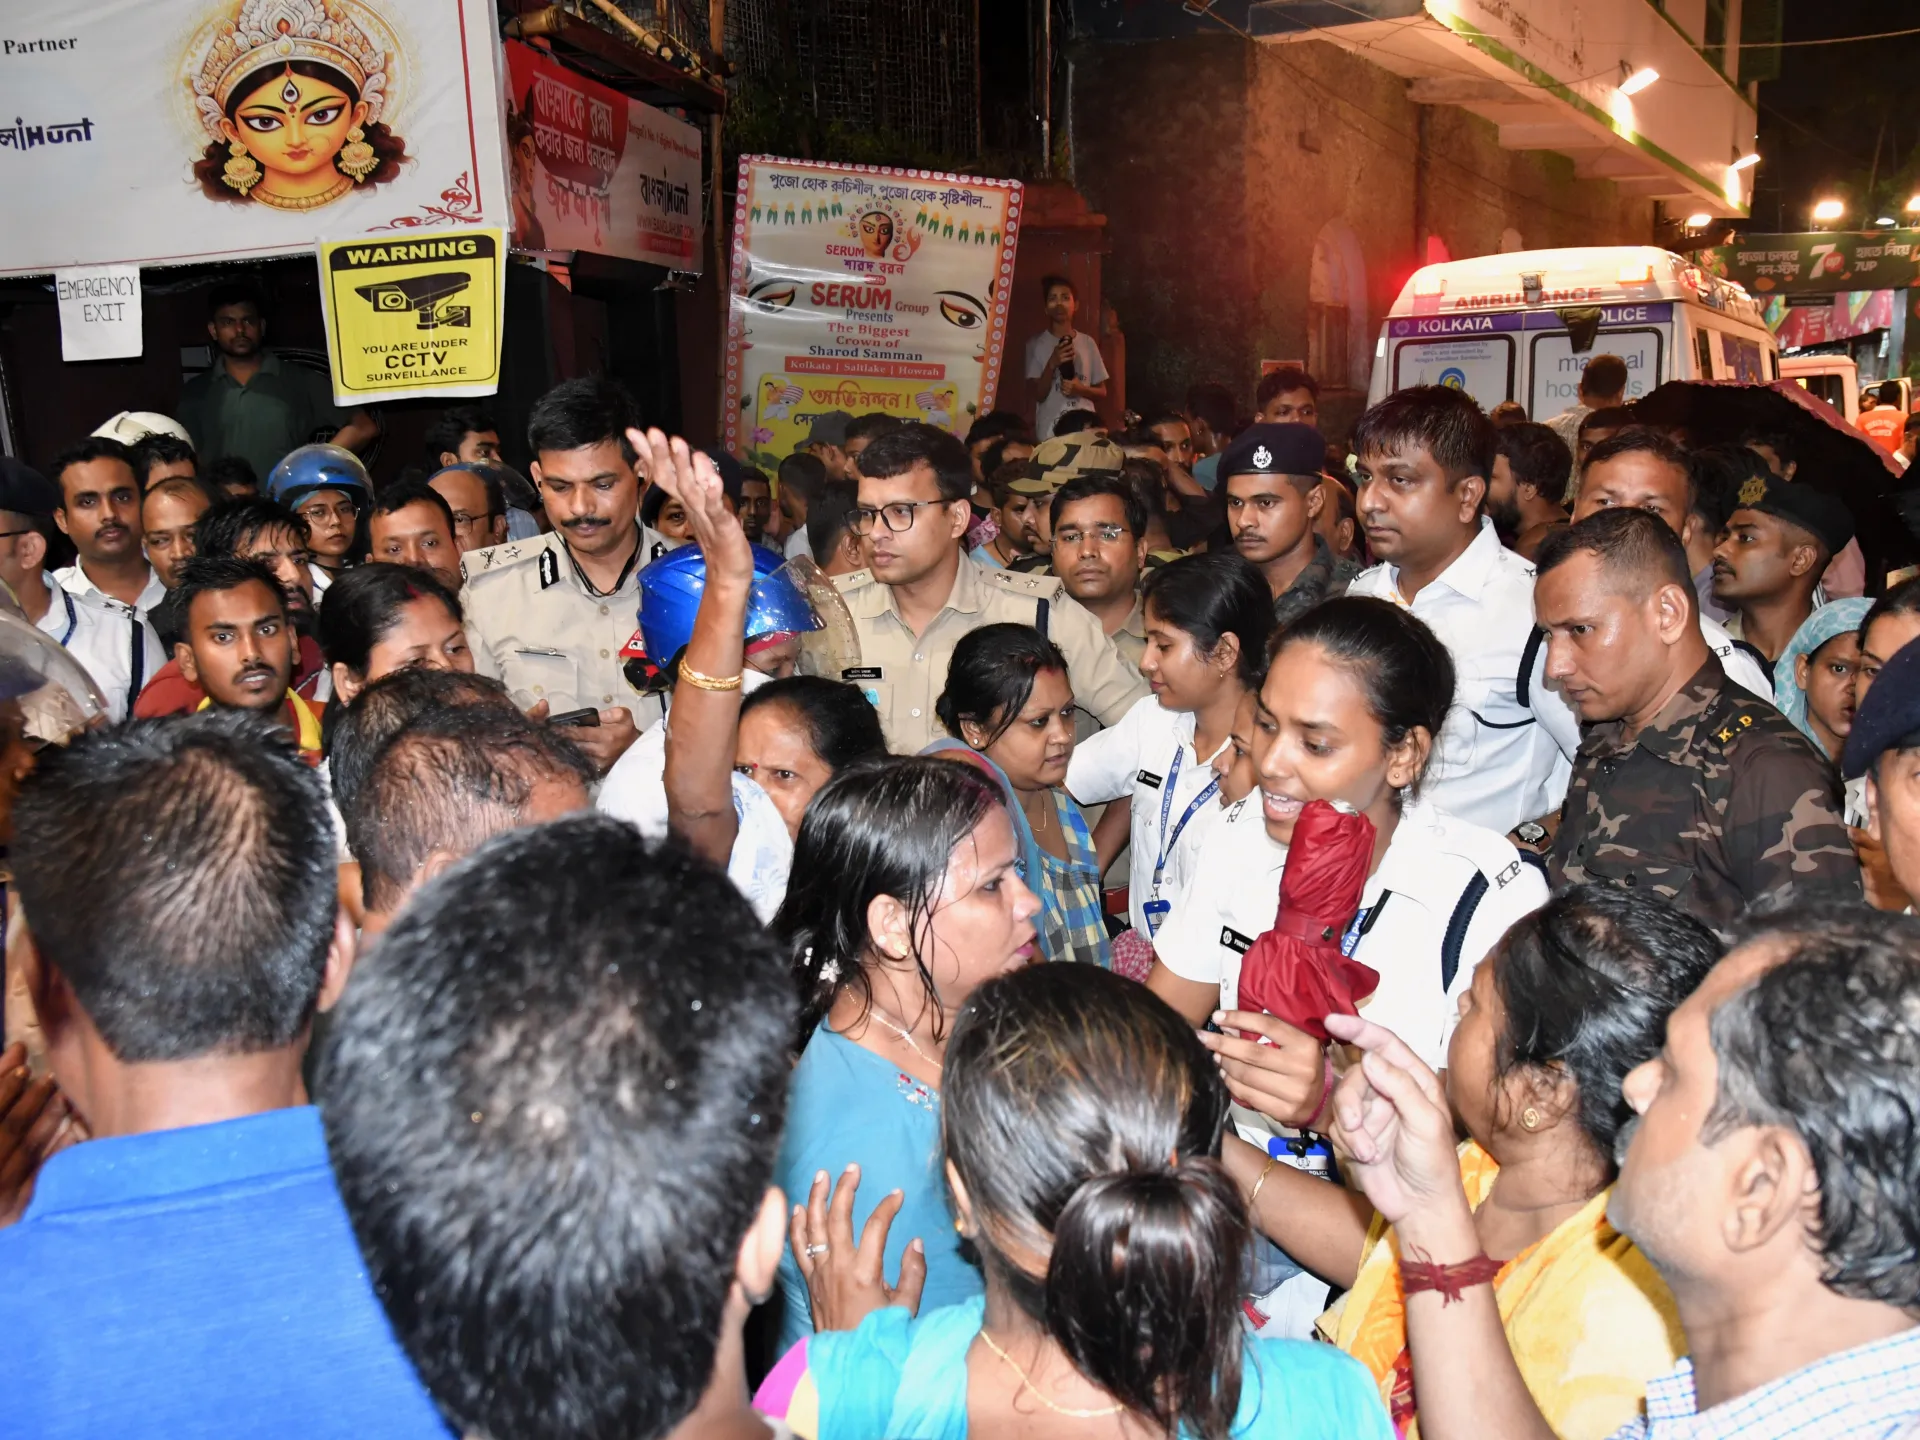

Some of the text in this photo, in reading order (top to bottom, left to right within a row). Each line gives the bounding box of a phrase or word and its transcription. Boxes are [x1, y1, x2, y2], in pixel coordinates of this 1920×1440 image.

[3, 36, 78, 55] Partner
[533, 70, 585, 131] বাংলাকে
[534, 121, 562, 159] করার
[563, 132, 584, 163] জন্য
[769, 173, 799, 191] পুজো
[802, 176, 828, 192] হোক
[879, 185, 909, 202] পুজো
[911, 187, 937, 203] হোক
[346, 239, 477, 266] WARNING
[825, 244, 865, 257] SERUM
[1737, 251, 1765, 266] পুজো
[844, 259, 875, 272] শারদ
[1854, 260, 1877, 272] 7UP
[58, 276, 136, 301] EMERGENCY
[1454, 287, 1602, 309] AMBULANCE
[810, 282, 930, 316] SERUM Group
[83, 302, 126, 322] EXIT
[846, 308, 894, 323] Presents
[1417, 306, 1648, 333] KOLKATA OLICE
[827, 322, 911, 339] The Biggest
[362, 338, 468, 355] YOU ARE UNDER
[836, 336, 901, 348] Crown of
[385, 351, 448, 369] CCTV
[809, 345, 923, 361] Sharod Samman
[1558, 350, 1644, 372] maal
[366, 366, 467, 382] SURVEILLANCE
[790, 360, 939, 377] Kolkata Saltlake Howrah
[1163, 788, 1173, 811] POLICE
[1199, 781, 1220, 803] KOLKAT
